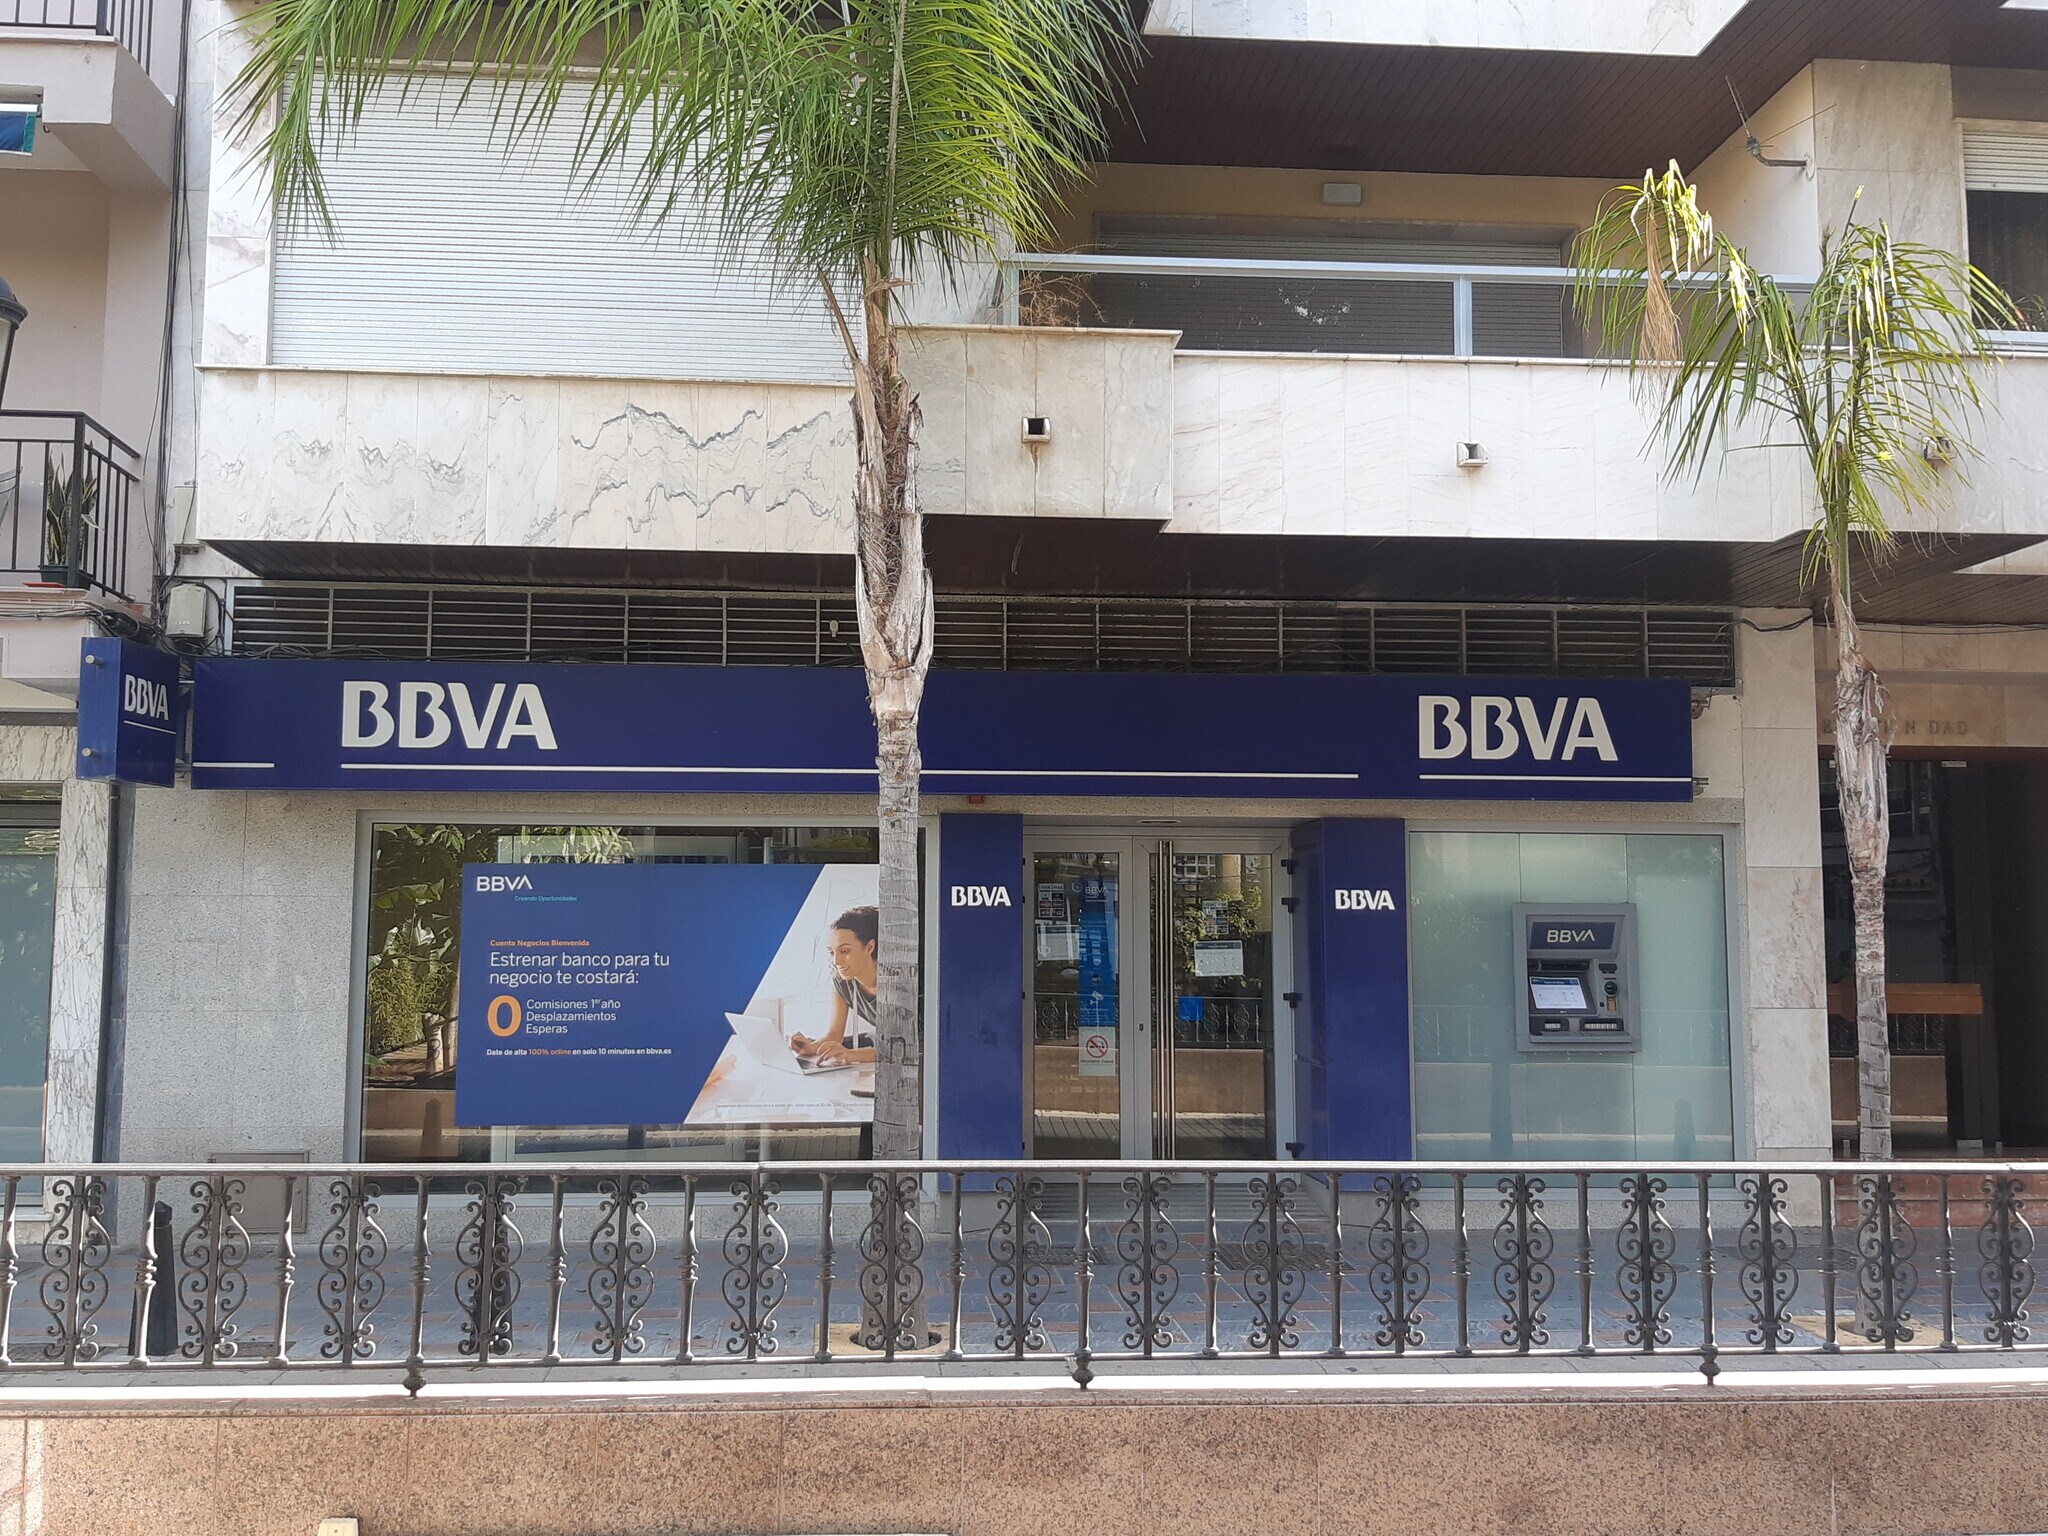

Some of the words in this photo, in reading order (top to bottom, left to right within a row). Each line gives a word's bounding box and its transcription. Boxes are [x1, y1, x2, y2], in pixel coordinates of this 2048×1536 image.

[124, 674, 169, 721] BBVA
[341, 680, 558, 750] BBVA
[1418, 695, 1619, 762] BBVA
[476, 874, 533, 892] BBVA
[1085, 886, 1109, 894] BBVA
[951, 885, 1012, 907] BBVA
[1334, 889, 1396, 911] BBVA
[490, 939, 516, 947] Cuenta
[517, 939, 550, 948] Negocios
[551, 939, 590, 947] Bienvenida
[1546, 928, 1596, 943] BBVA
[490, 952, 559, 967] Estrenar
[561, 952, 611, 967] banco
[614, 955, 650, 970] para
[653, 954, 670, 967] tu
[489, 970, 553, 988] negocio
[556, 971, 572, 985] te
[575, 969, 639, 985] costará:
[526, 999, 589, 1010] Comisiones
[487, 994, 522, 1037] 0
[526, 1011, 617, 1024] Desplazamientos
[525, 1023, 569, 1036] Esperas
[486, 1048, 503, 1056] Date
[504, 1048, 513, 1056] de
[514, 1048, 528, 1056] alta
[646, 1047, 672, 1055] bbva.es
